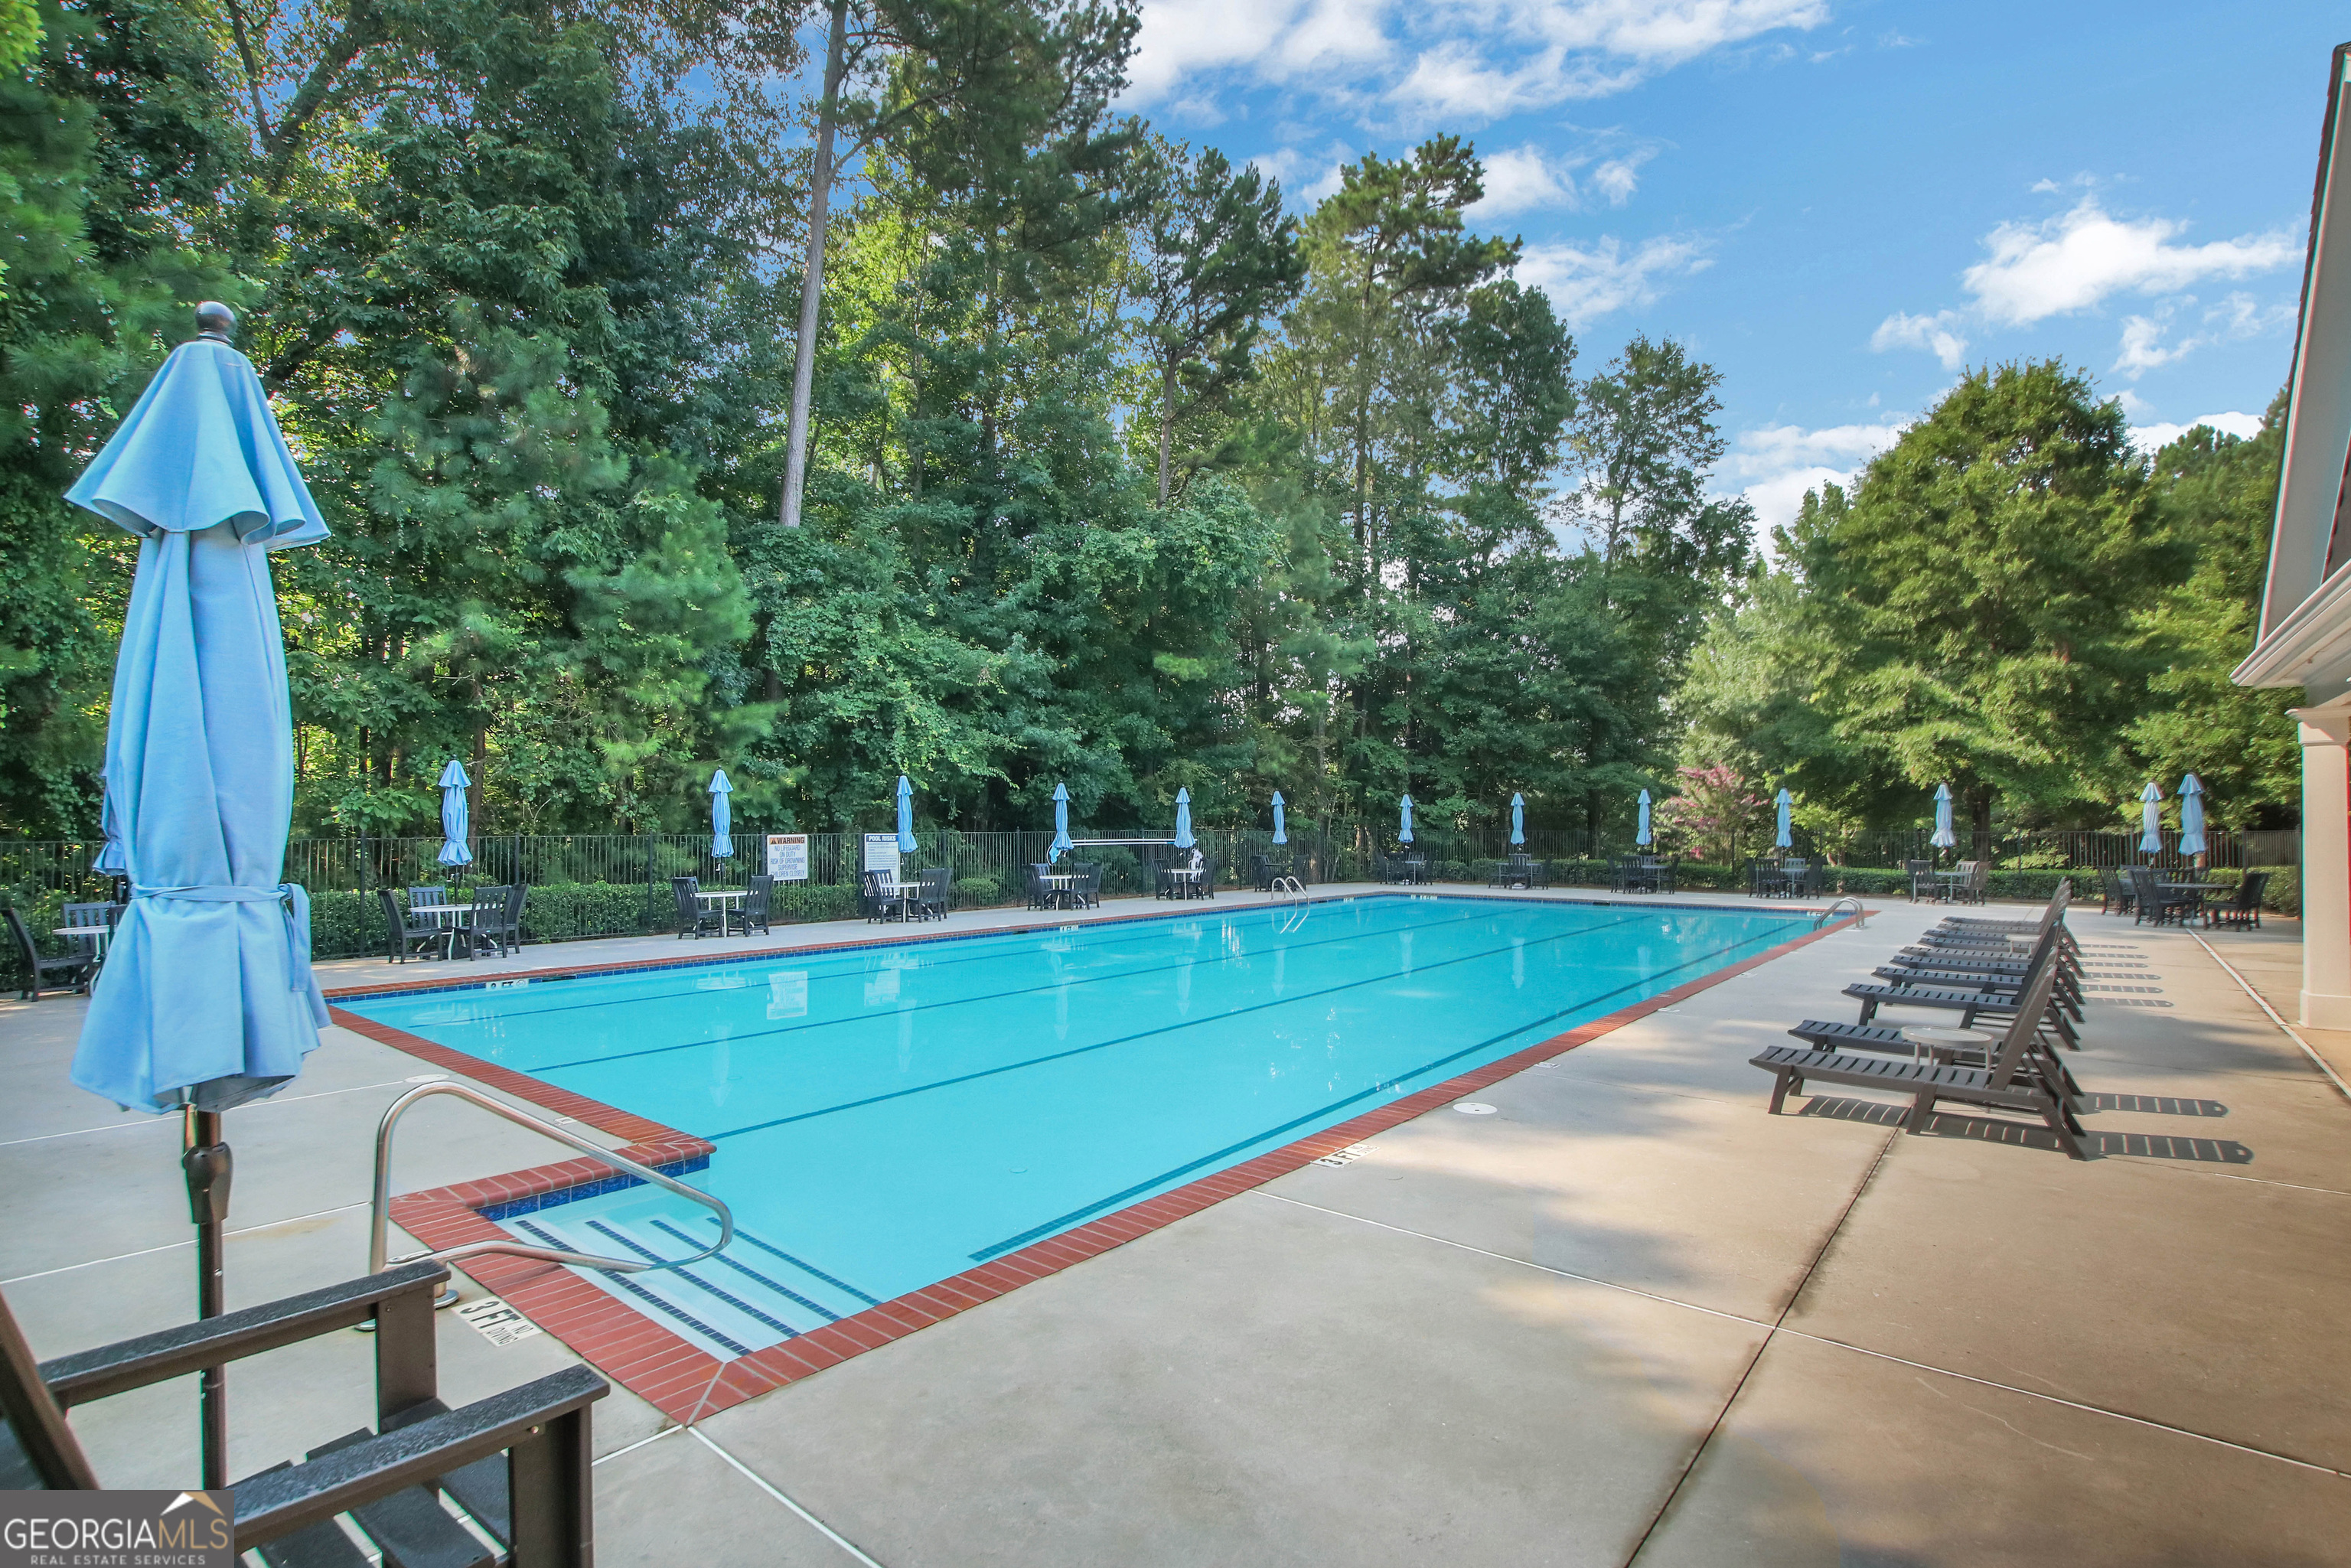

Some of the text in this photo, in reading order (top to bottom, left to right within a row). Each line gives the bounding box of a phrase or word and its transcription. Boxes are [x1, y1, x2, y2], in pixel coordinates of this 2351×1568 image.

[1332, 1150, 1361, 1160] FT
[460, 1301, 522, 1329] 3 FT
[486, 1327, 518, 1345] DIVING
[510, 1324, 534, 1334] NO
